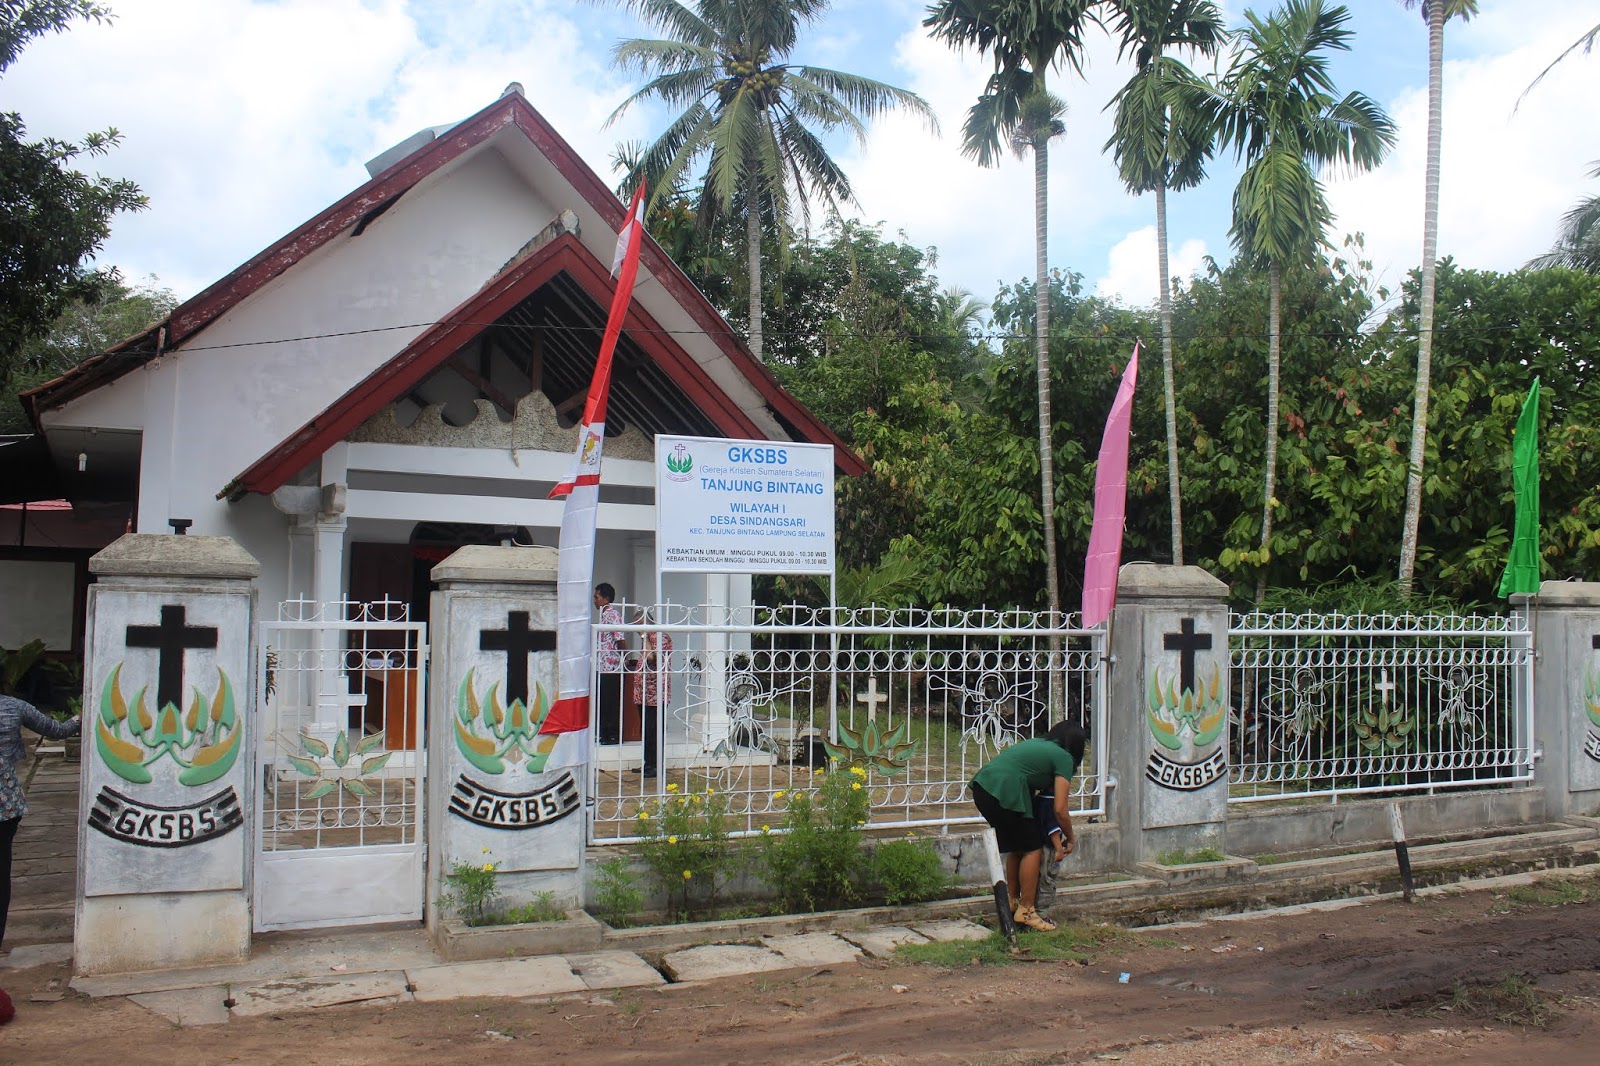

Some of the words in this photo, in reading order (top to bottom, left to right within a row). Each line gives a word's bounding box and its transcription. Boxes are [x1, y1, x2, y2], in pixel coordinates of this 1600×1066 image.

[728, 447, 788, 464] GKSBS
[700, 465, 727, 475] (Gereja
[730, 466, 755, 475] Kristen
[758, 467, 793, 476] Sumatera
[795, 468, 825, 478] Selatan)
[700, 478, 763, 492] TANJUNG
[767, 481, 824, 494] BINTANG
[730, 503, 779, 513] WILAYAH
[782, 504, 786, 513] I
[710, 515, 737, 525] DESA
[739, 516, 806, 527] SINDANGSARI
[737, 528, 764, 536] BINTANG
[766, 529, 797, 537] LAMPUNG
[667, 547, 704, 555] KEBAKTIAN
[1161, 762, 1214, 785] GKSBS
[472, 793, 558, 823] GKSBS
[114, 807, 216, 840] GKSBS
